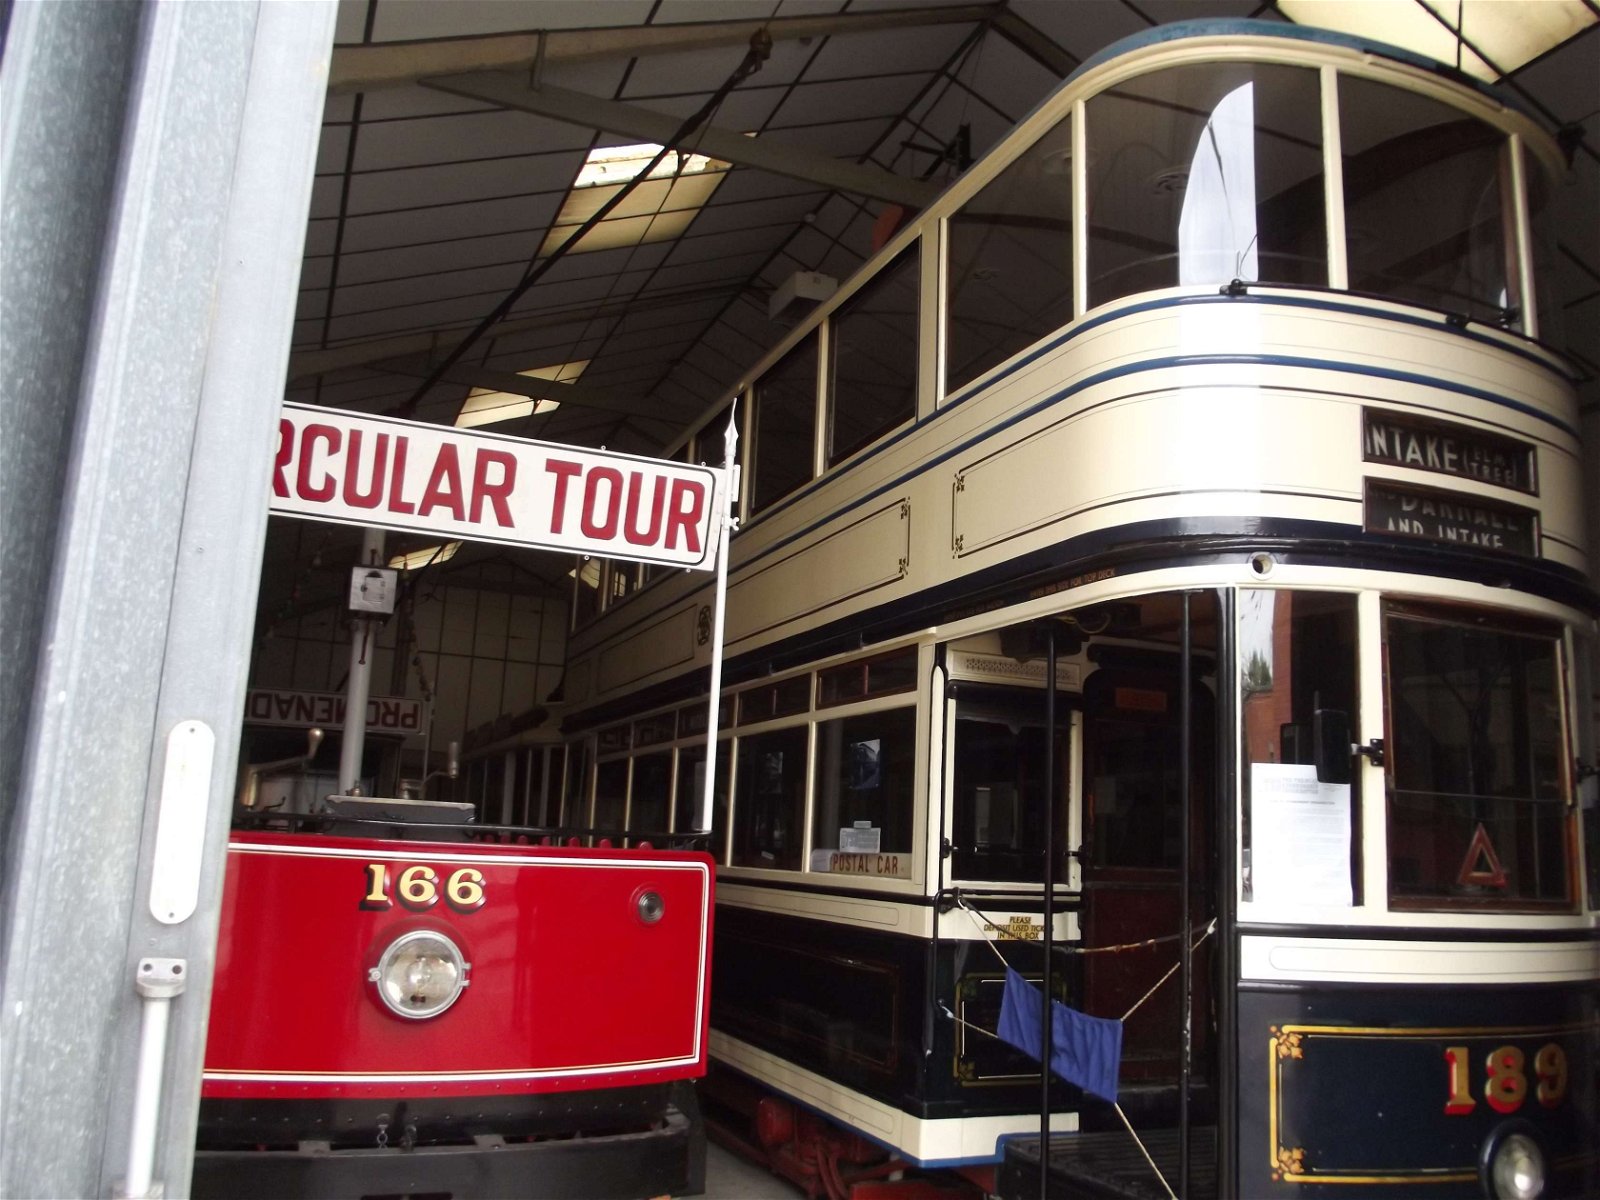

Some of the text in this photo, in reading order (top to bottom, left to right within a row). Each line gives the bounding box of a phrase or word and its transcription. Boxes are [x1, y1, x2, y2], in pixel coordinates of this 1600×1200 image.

[1365, 423, 1459, 472] INTAKE
[545, 459, 706, 553] TOUR
[1388, 517, 1504, 548] AND INTAKE
[246, 691, 420, 730] PROENAD
[832, 854, 899, 875] POSTAL CAR
[361, 863, 487, 913] 166
[997, 931, 1005, 939] IN
[1025, 932, 1040, 940] BOX
[1009, 916, 1032, 925] PLEASE
[1012, 924, 1029, 932] USED
[1444, 1042, 1568, 1115] 189
